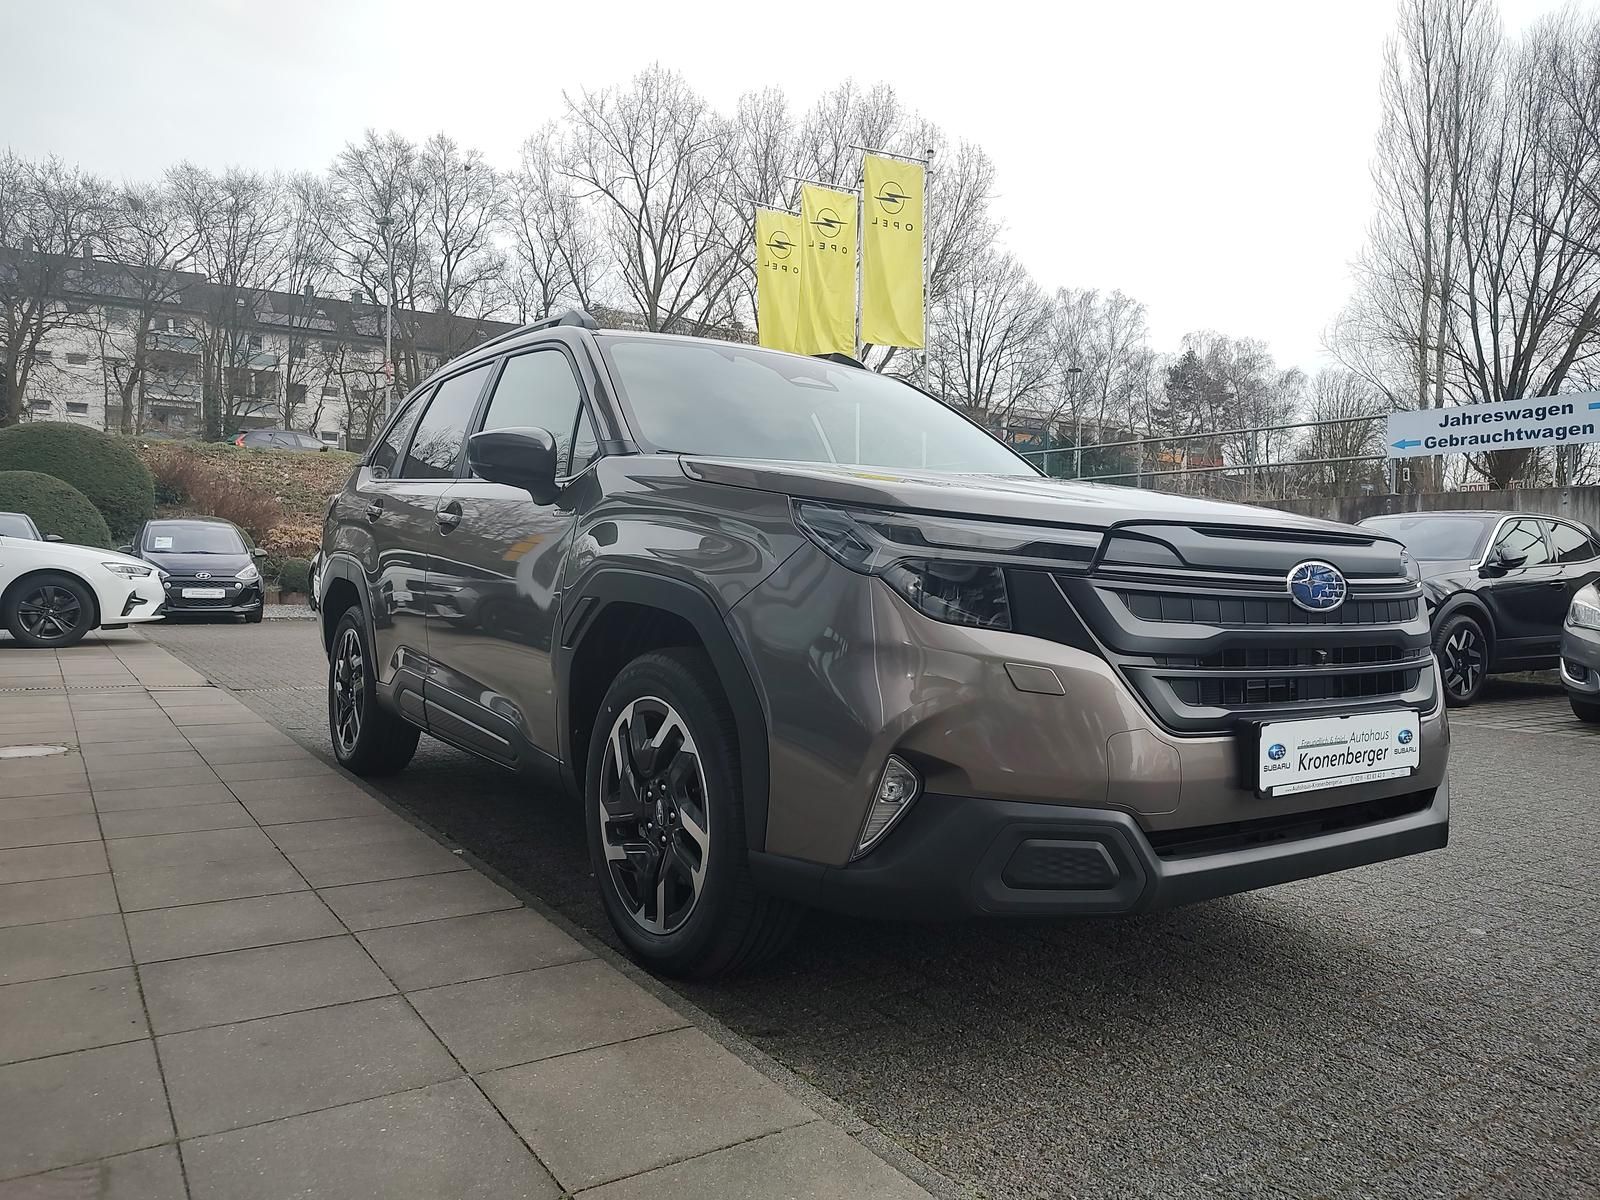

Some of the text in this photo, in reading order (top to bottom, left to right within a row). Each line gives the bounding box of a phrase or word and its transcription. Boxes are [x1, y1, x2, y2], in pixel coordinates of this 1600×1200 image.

[1438, 403, 1574, 428] Jahreswagen
[1424, 423, 1595, 449] Gebrauchtwagen
[1349, 729, 1390, 744] Autohaus
[1298, 746, 1390, 772] Kronenberger
[1394, 746, 1417, 755] SUBARU
[1263, 762, 1291, 773] SUBARU
